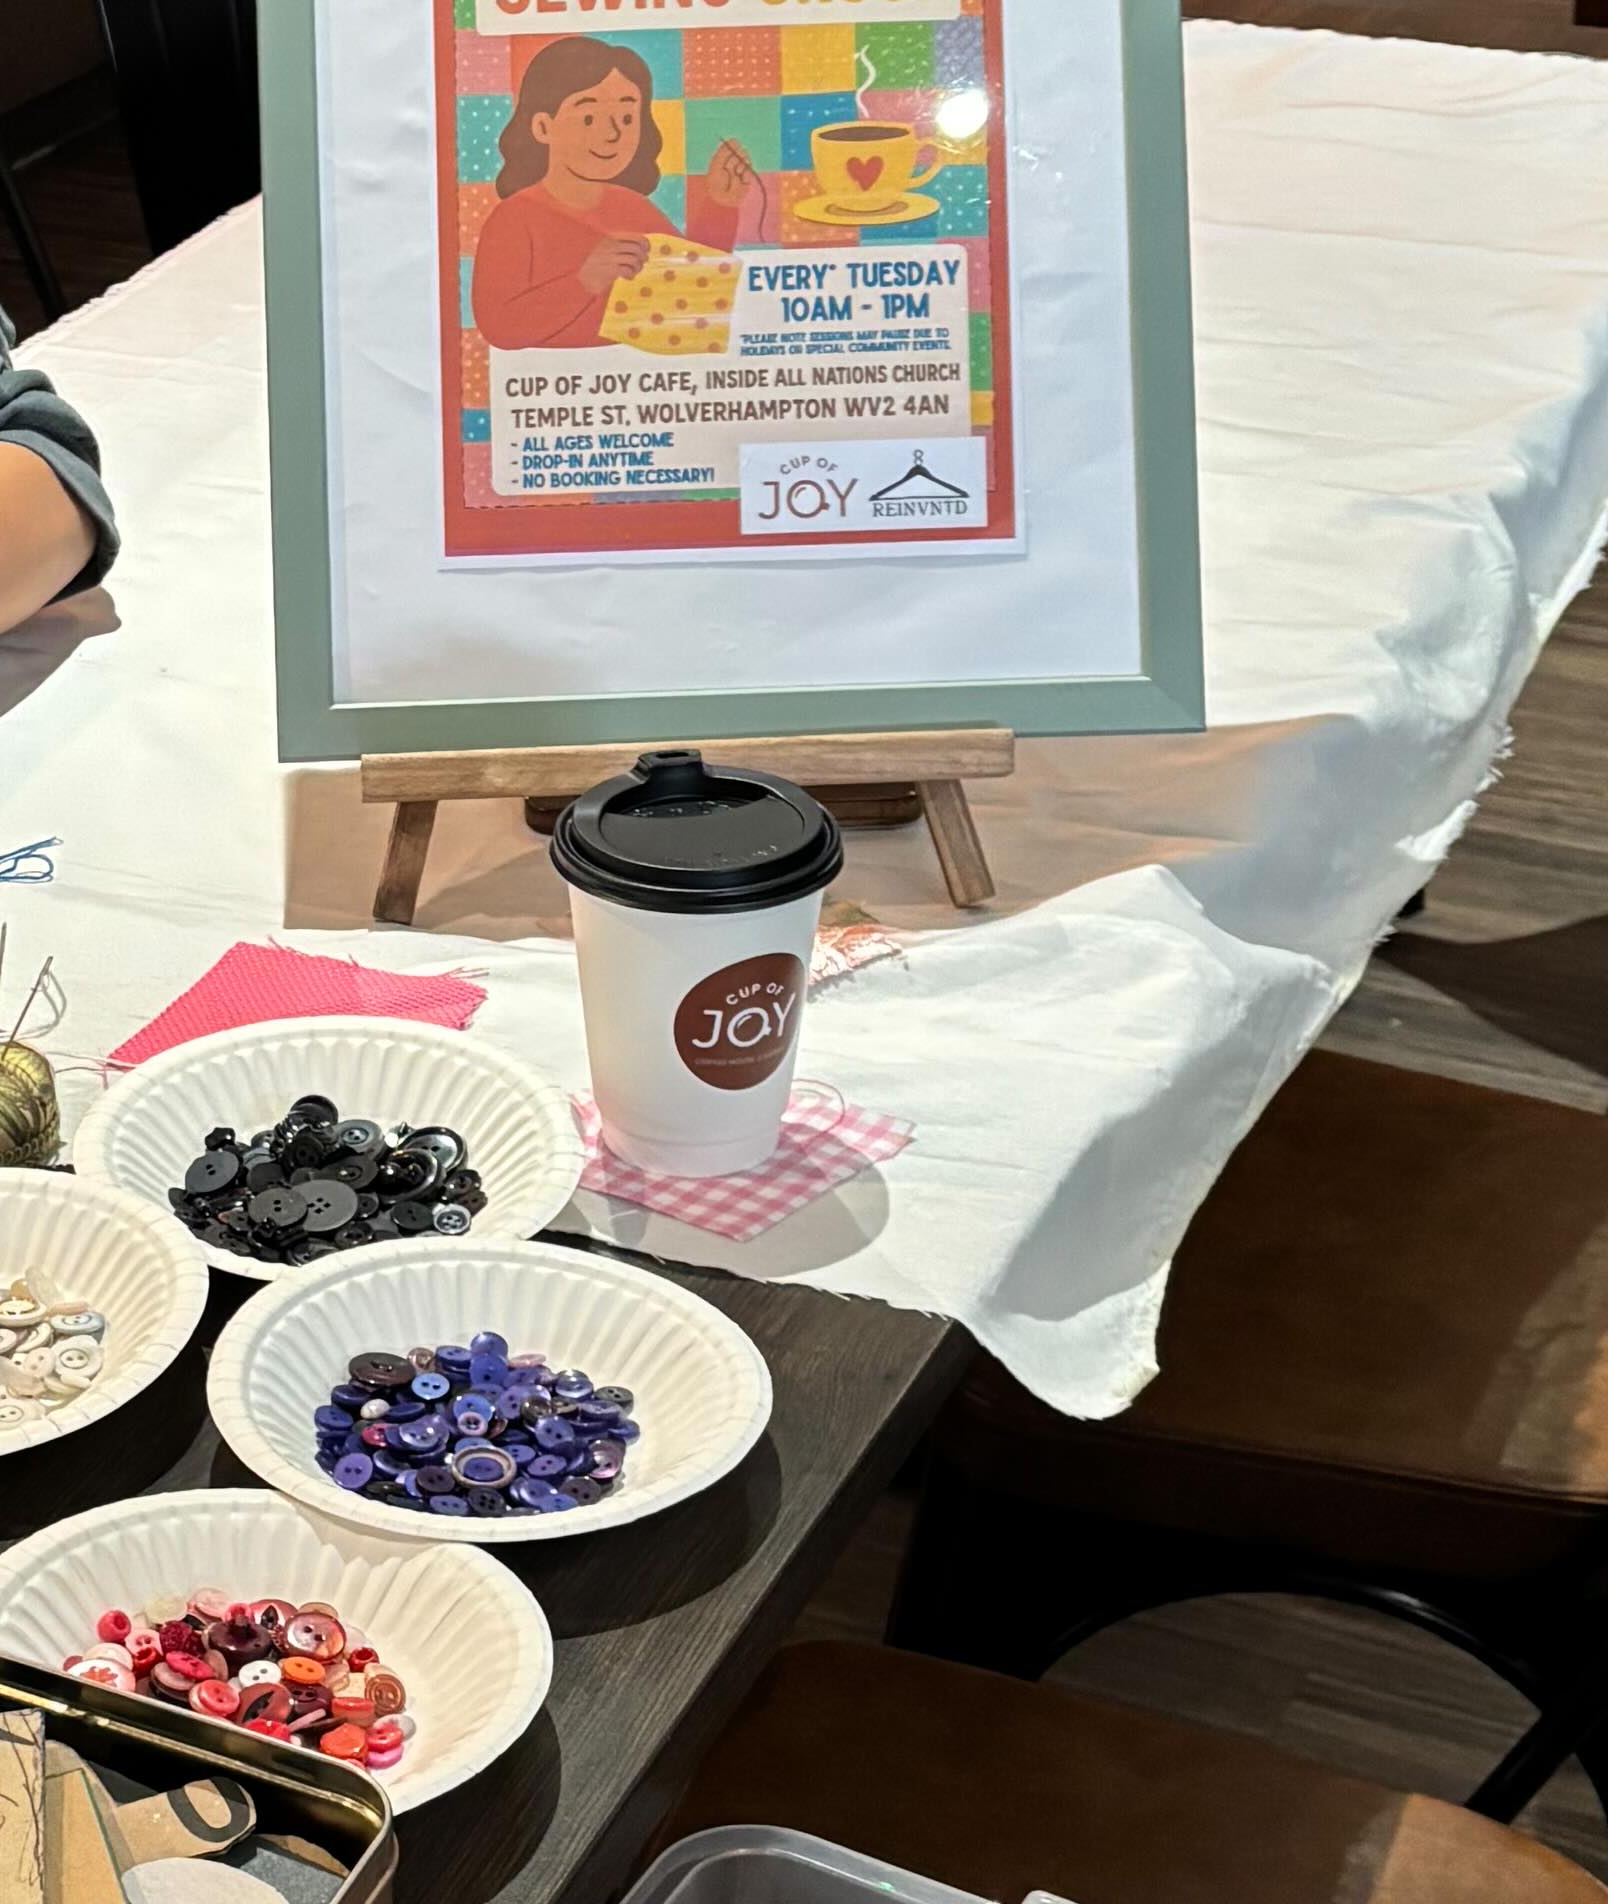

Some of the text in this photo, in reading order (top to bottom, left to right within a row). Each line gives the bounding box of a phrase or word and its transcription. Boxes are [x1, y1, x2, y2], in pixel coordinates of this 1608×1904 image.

[846, 259, 961, 289] TUESDAY
[781, 295, 853, 322] 10AM
[880, 293, 930, 319] 1PM
[505, 363, 961, 397] CUP OF JOY CAFE, INSIDE ALL NATIONS CHURCH
[511, 406, 594, 429] TEMPLE
[636, 398, 837, 425] WOLVERHAMPTON
[843, 395, 896, 417] WV2
[903, 394, 949, 415] 4AN
[522, 436, 549, 452] ALL
[554, 435, 593, 451] AGES
[598, 432, 674, 448] WELCOME
[522, 453, 584, 470] DROP-IN
[588, 451, 654, 468] ANYTIME
[780, 455, 838, 475] CUP OF
[522, 473, 545, 488] NO
[550, 471, 621, 487] BOOKING
[626, 467, 714, 484] NECESSARY!
[758, 478, 859, 520] JOY
[872, 500, 968, 518] REINVNTD
[726, 982, 785, 1005] CUP OF
[692, 992, 796, 1048] JOY
